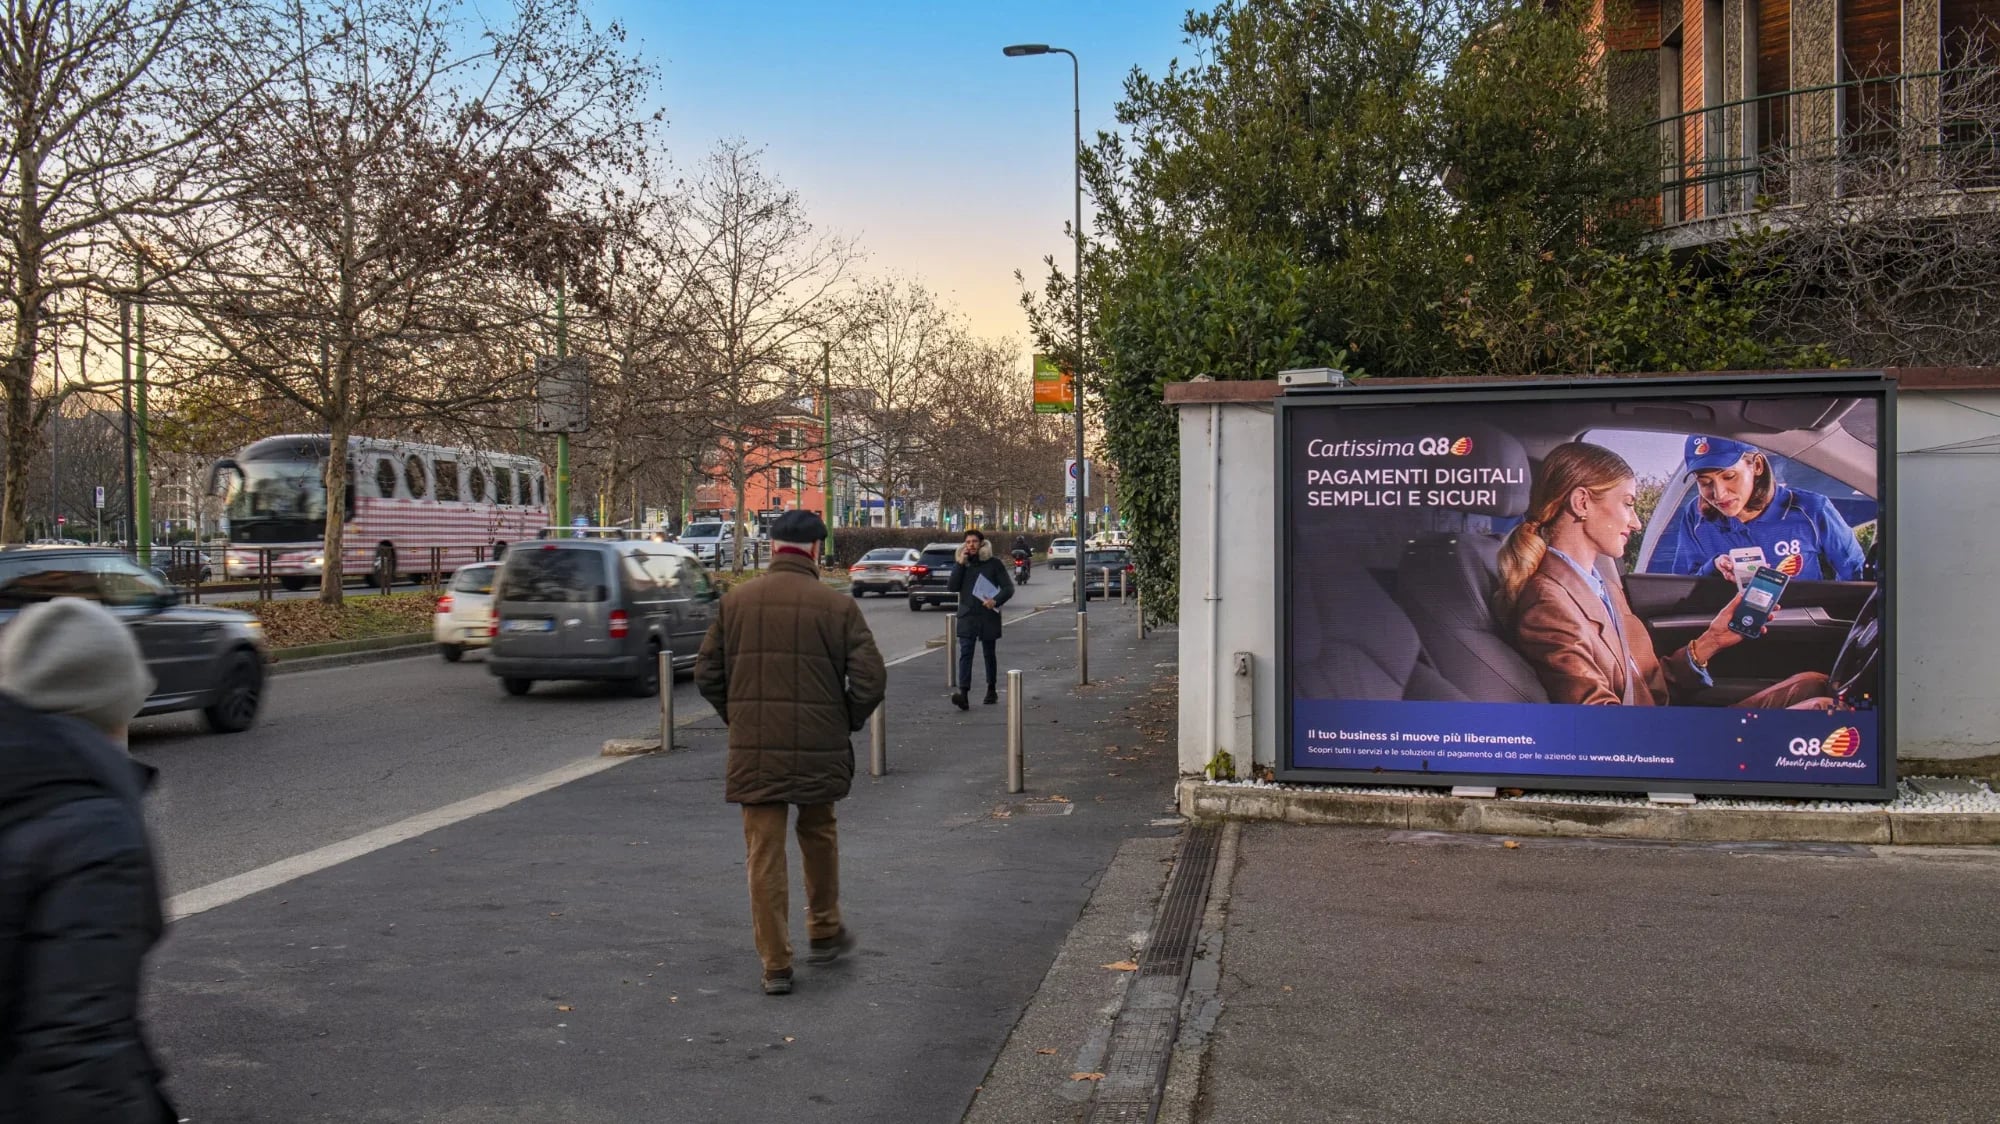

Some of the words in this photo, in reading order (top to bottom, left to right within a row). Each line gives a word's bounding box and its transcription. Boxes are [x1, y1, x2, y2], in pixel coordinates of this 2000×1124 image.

[1308, 439, 1415, 457] Cartissima
[1418, 437, 1450, 456] Q8
[1308, 469, 1428, 485] PAGAMENTI
[1435, 468, 1524, 484] DIGITALI
[1308, 490, 1401, 506] SEMPLICI
[1408, 490, 1421, 506] E
[1427, 490, 1496, 506] SICURI
[1774, 539, 1800, 556] Q8
[1308, 729, 1315, 739] Il
[1318, 730, 1337, 739] tuo
[1340, 730, 1387, 741] business
[1390, 731, 1399, 741] si
[1402, 733, 1440, 742] muove
[1443, 732, 1461, 744] più
[1464, 733, 1536, 744] liberamente.
[1308, 746, 1333, 755] Scopri
[1357, 747, 1383, 755] servizi
[1400, 748, 1436, 756] soluzioni
[1447, 750, 1493, 759] pagamento
[1504, 751, 1517, 759] Q8
[1519, 753, 1533, 761] per
[1544, 753, 1576, 761] aziende
[1589, 754, 1674, 764] www.Q8.it/business
[1789, 737, 1820, 756] Q8
[1820, 758, 1867, 768] liberamente
